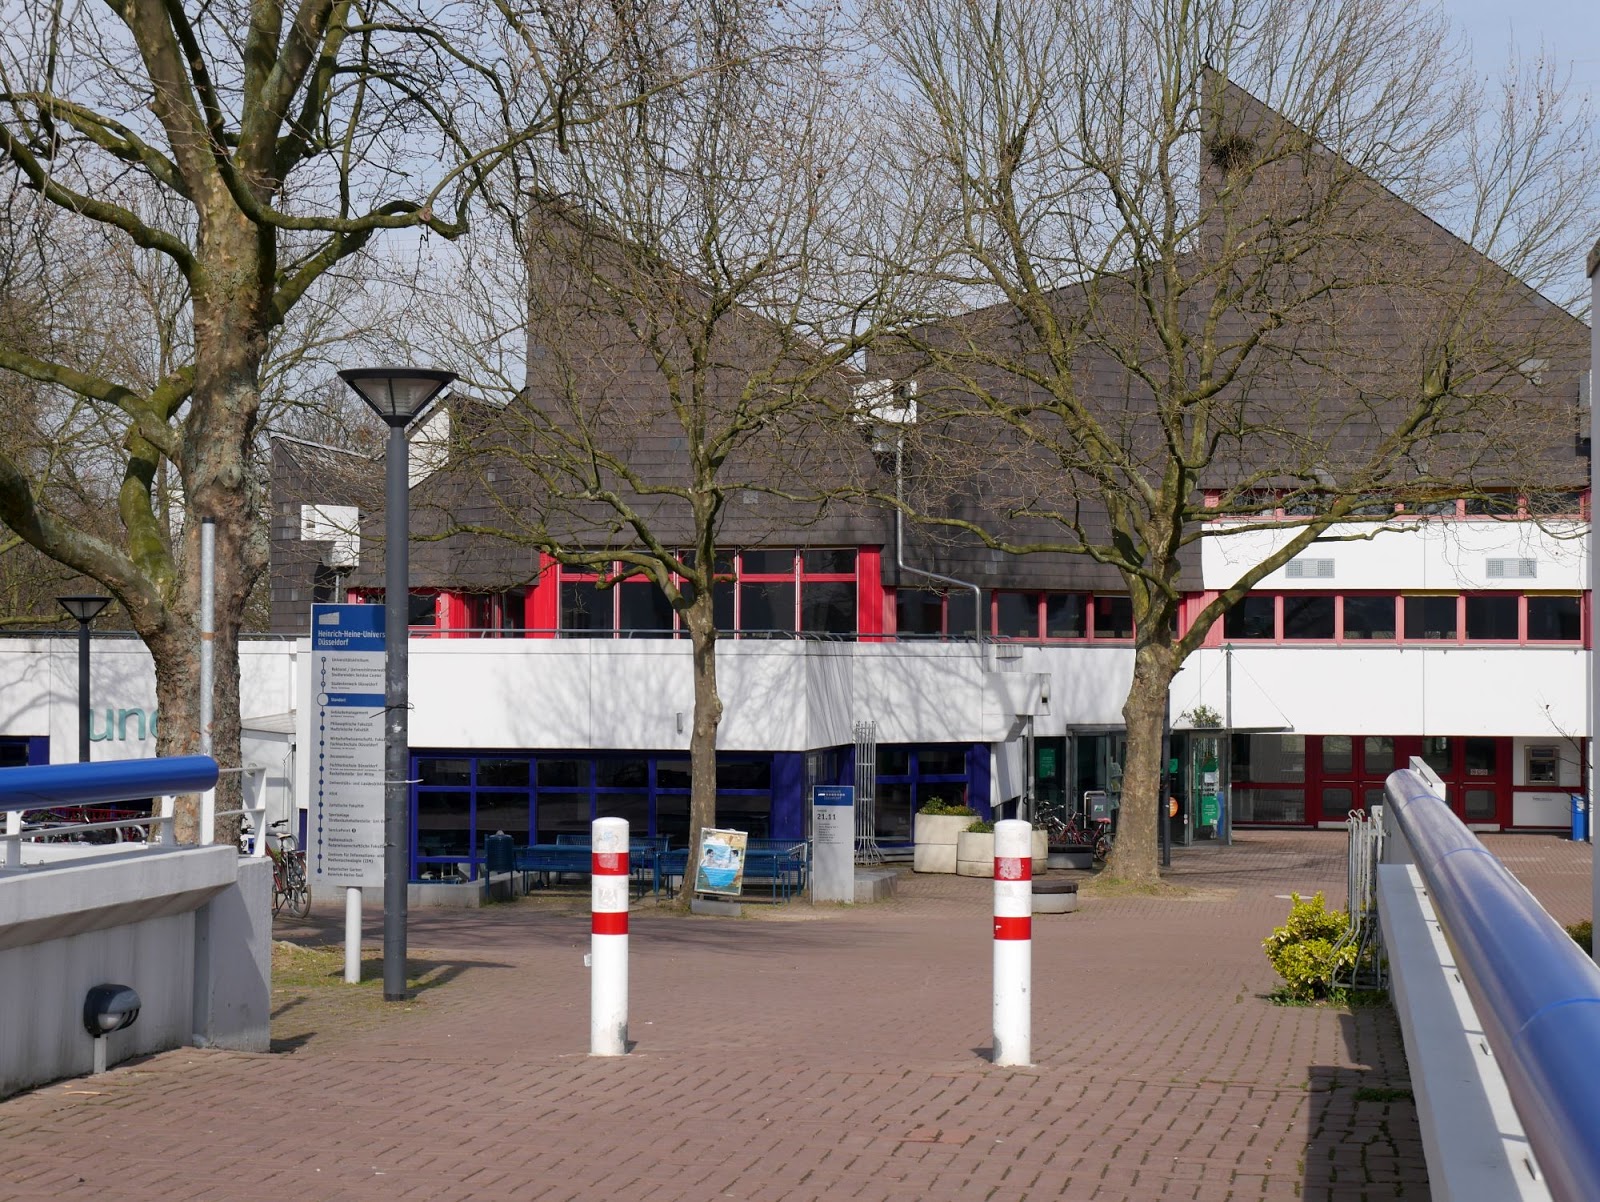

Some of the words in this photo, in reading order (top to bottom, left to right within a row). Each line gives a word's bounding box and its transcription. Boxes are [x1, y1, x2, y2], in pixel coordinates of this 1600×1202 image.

[318, 638, 348, 646] Düsseldorf
[89, 708, 158, 742] un
[817, 813, 836, 821] 21.11
